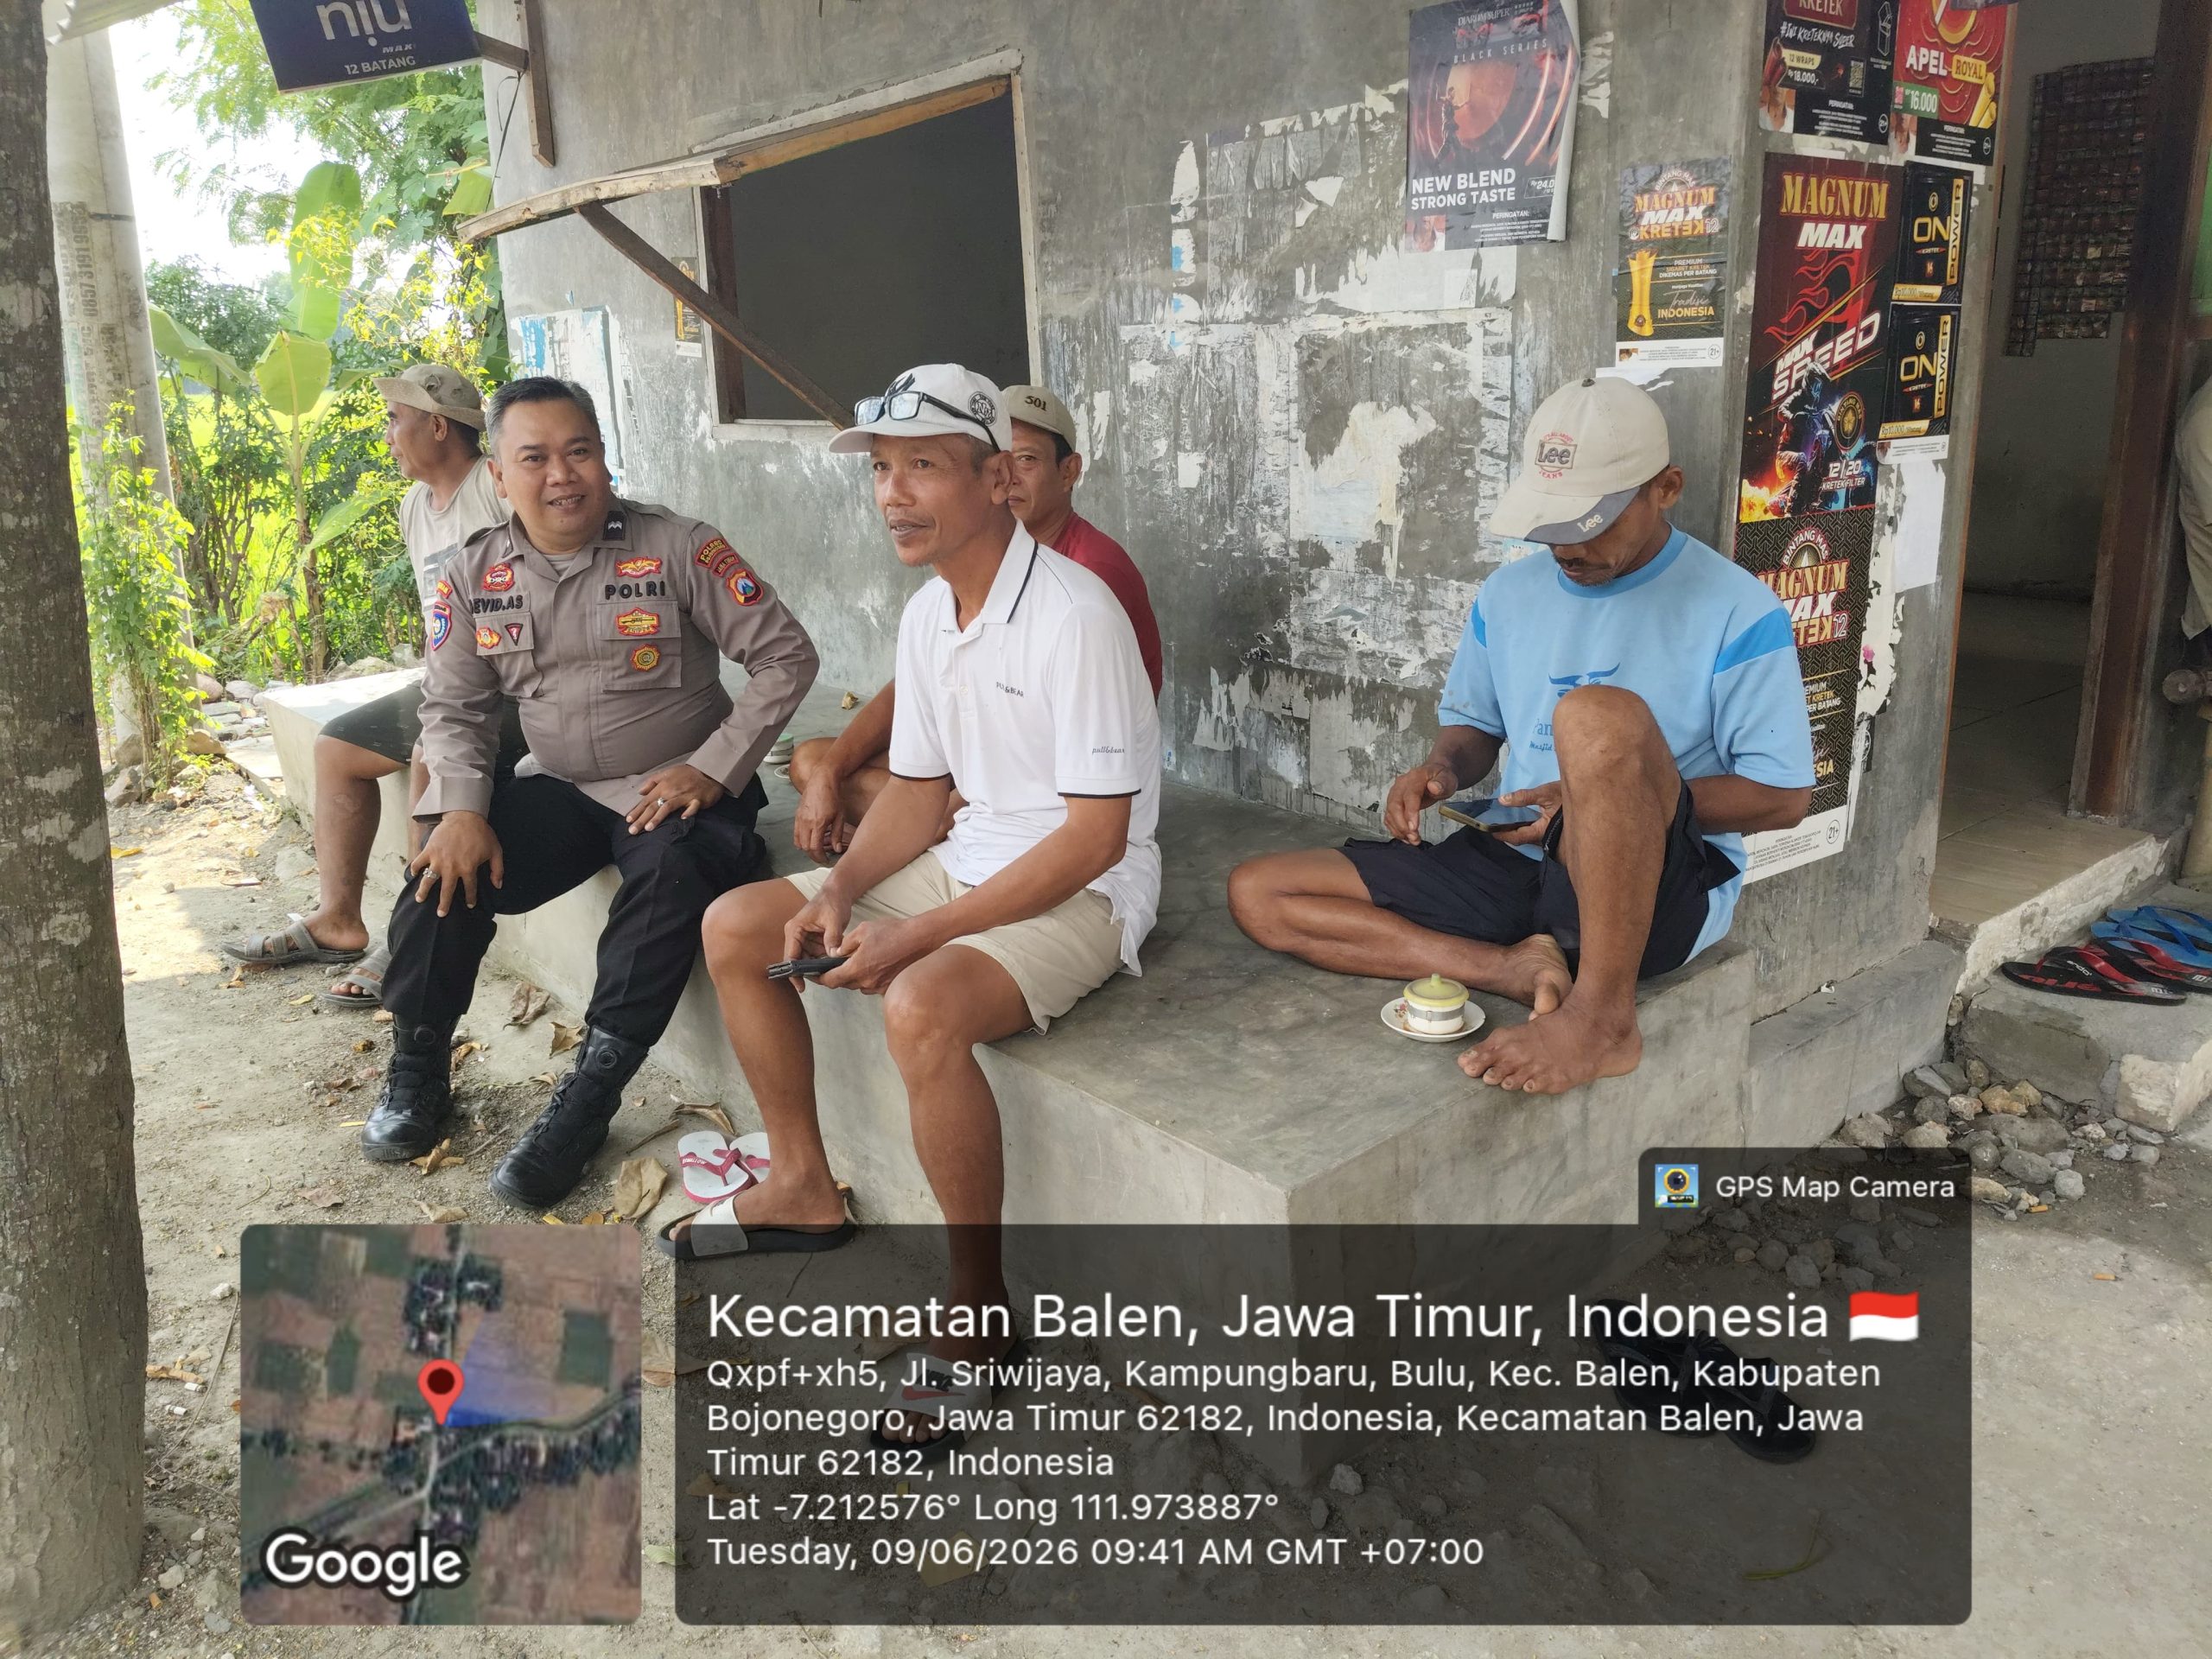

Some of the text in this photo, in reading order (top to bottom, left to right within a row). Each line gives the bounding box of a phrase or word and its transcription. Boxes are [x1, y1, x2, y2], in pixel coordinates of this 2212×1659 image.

[382, 43, 412, 54] MAX
[1454, 39, 1547, 64] BLACK SERIES
[345, 56, 416, 75] 12 BATANG
[1796, 54, 1815, 66] WRAPS
[1905, 45, 1948, 76] APEL
[1955, 59, 1983, 79] ROYAL
[1412, 168, 1516, 195] NEW BLEND
[1655, 170, 1682, 191] BINTANG
[1411, 188, 1516, 210] STRONG TASTE
[1635, 187, 1715, 213] MAGNUM
[1780, 174, 1890, 219] MAGNUM
[1492, 210, 1530, 219] PERINGATAN:
[1641, 205, 1707, 225] MAX
[1639, 219, 1705, 239] KRETEK
[1796, 222, 1867, 249] MAX
[1913, 216, 1950, 244] ON
[1948, 183, 1963, 279] POWER
[74, 246, 94, 280] 3191
[81, 282, 99, 317] 0857
[1657, 306, 1715, 319] INDONESIA
[1772, 312, 1881, 400] SPEED
[1776, 330, 1819, 374] MAX
[1900, 352, 1937, 382] ON
[1936, 320, 1949, 412] POWER
[1025, 395, 1047, 412] 501
[1538, 442, 1571, 465] Lee
[1821, 477, 1866, 491] KRETEK FILTER
[1577, 514, 1603, 533] Lee
[1783, 530, 1828, 565] BINTANG MAS
[605, 580, 666, 601] POLRI
[1833, 612, 1847, 639] 12
[1805, 681, 1827, 695] EMIUM
[1812, 690, 1834, 702] KRETEK
[1817, 697, 1841, 709] BATANG
[1827, 826, 1840, 839] 21+
